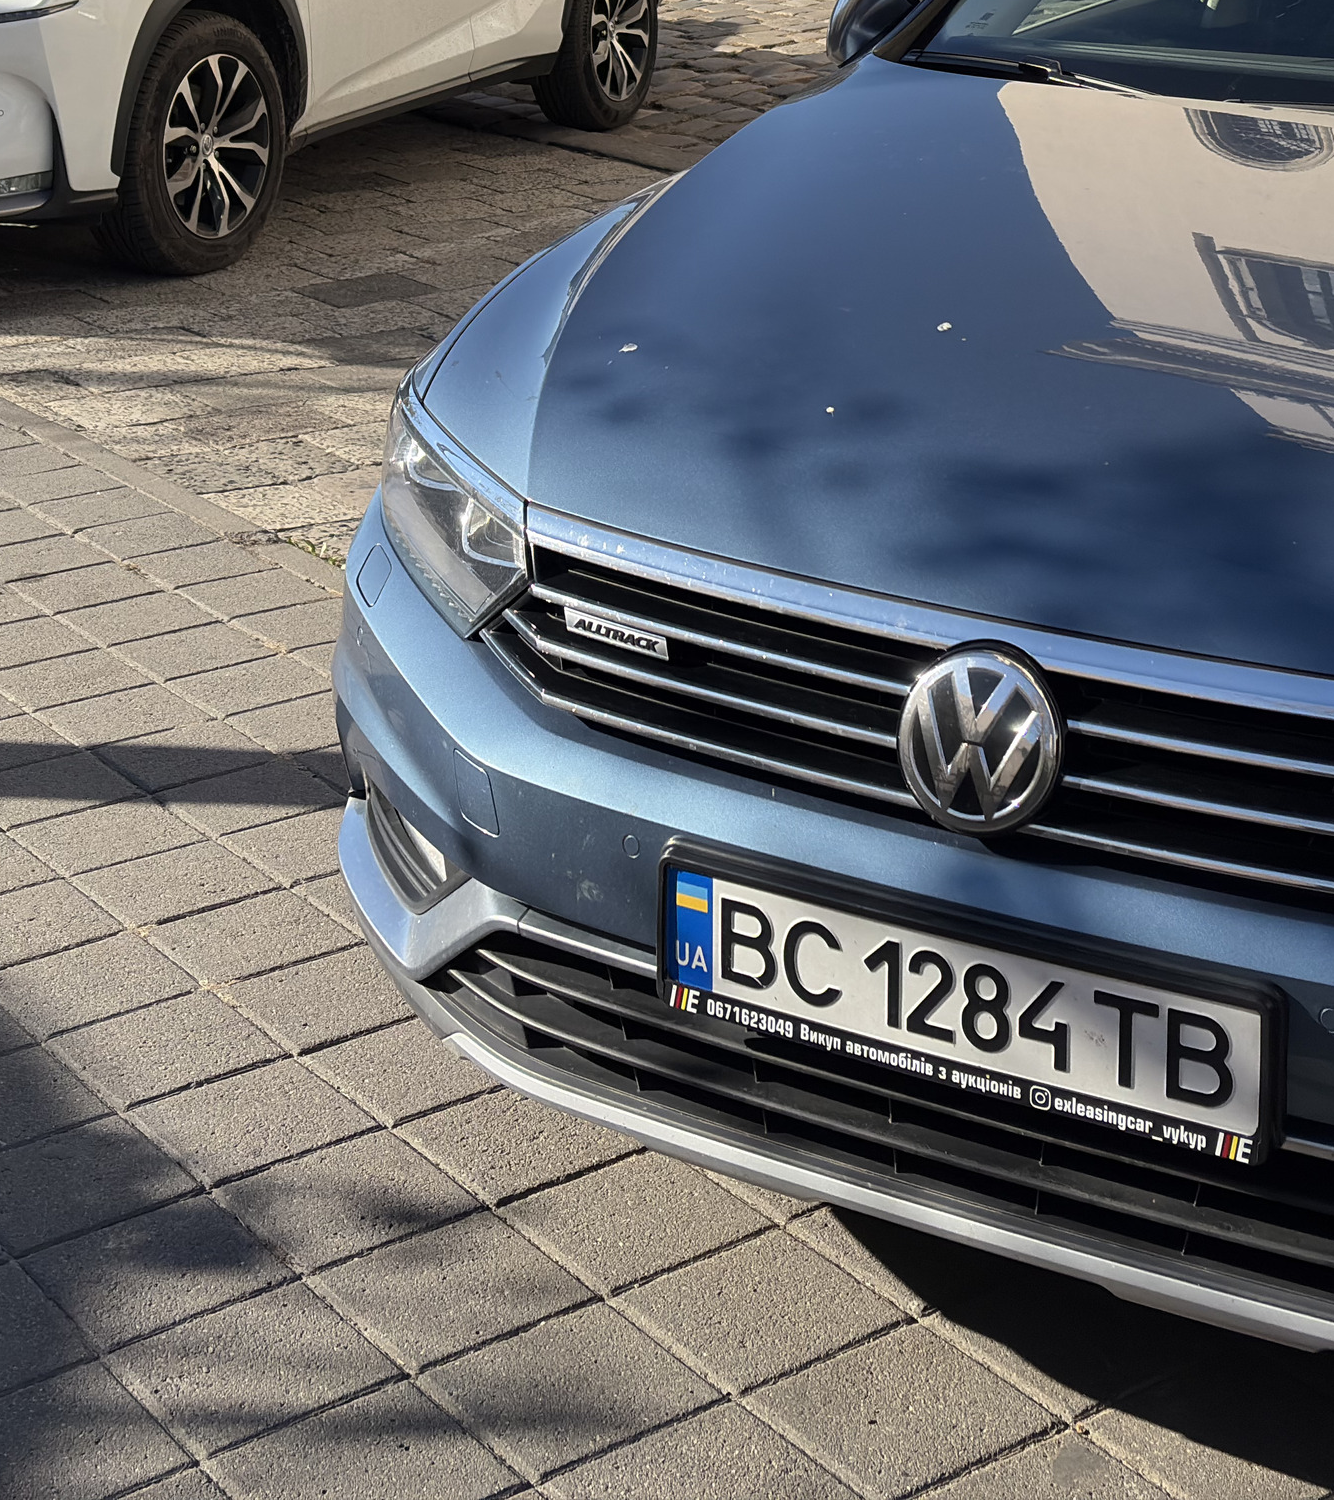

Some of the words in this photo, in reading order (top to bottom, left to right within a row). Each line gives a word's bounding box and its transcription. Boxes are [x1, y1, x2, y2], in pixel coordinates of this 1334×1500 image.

[574, 618, 660, 652] ALLTRACK
[675, 940, 708, 972] UA
[720, 897, 843, 1007] BC
[864, 939, 1068, 1073] 1284
[1094, 989, 1234, 1108] TB
[706, 998, 794, 1039] 0671623049
[800, 1023, 842, 1051] Викуп
[846, 1040, 934, 1077] автомобілів
[938, 1066, 947, 1080] з
[951, 1069, 1022, 1100] аукціонів
[1054, 1097, 1207, 1152] exleasingcar_vykyp
